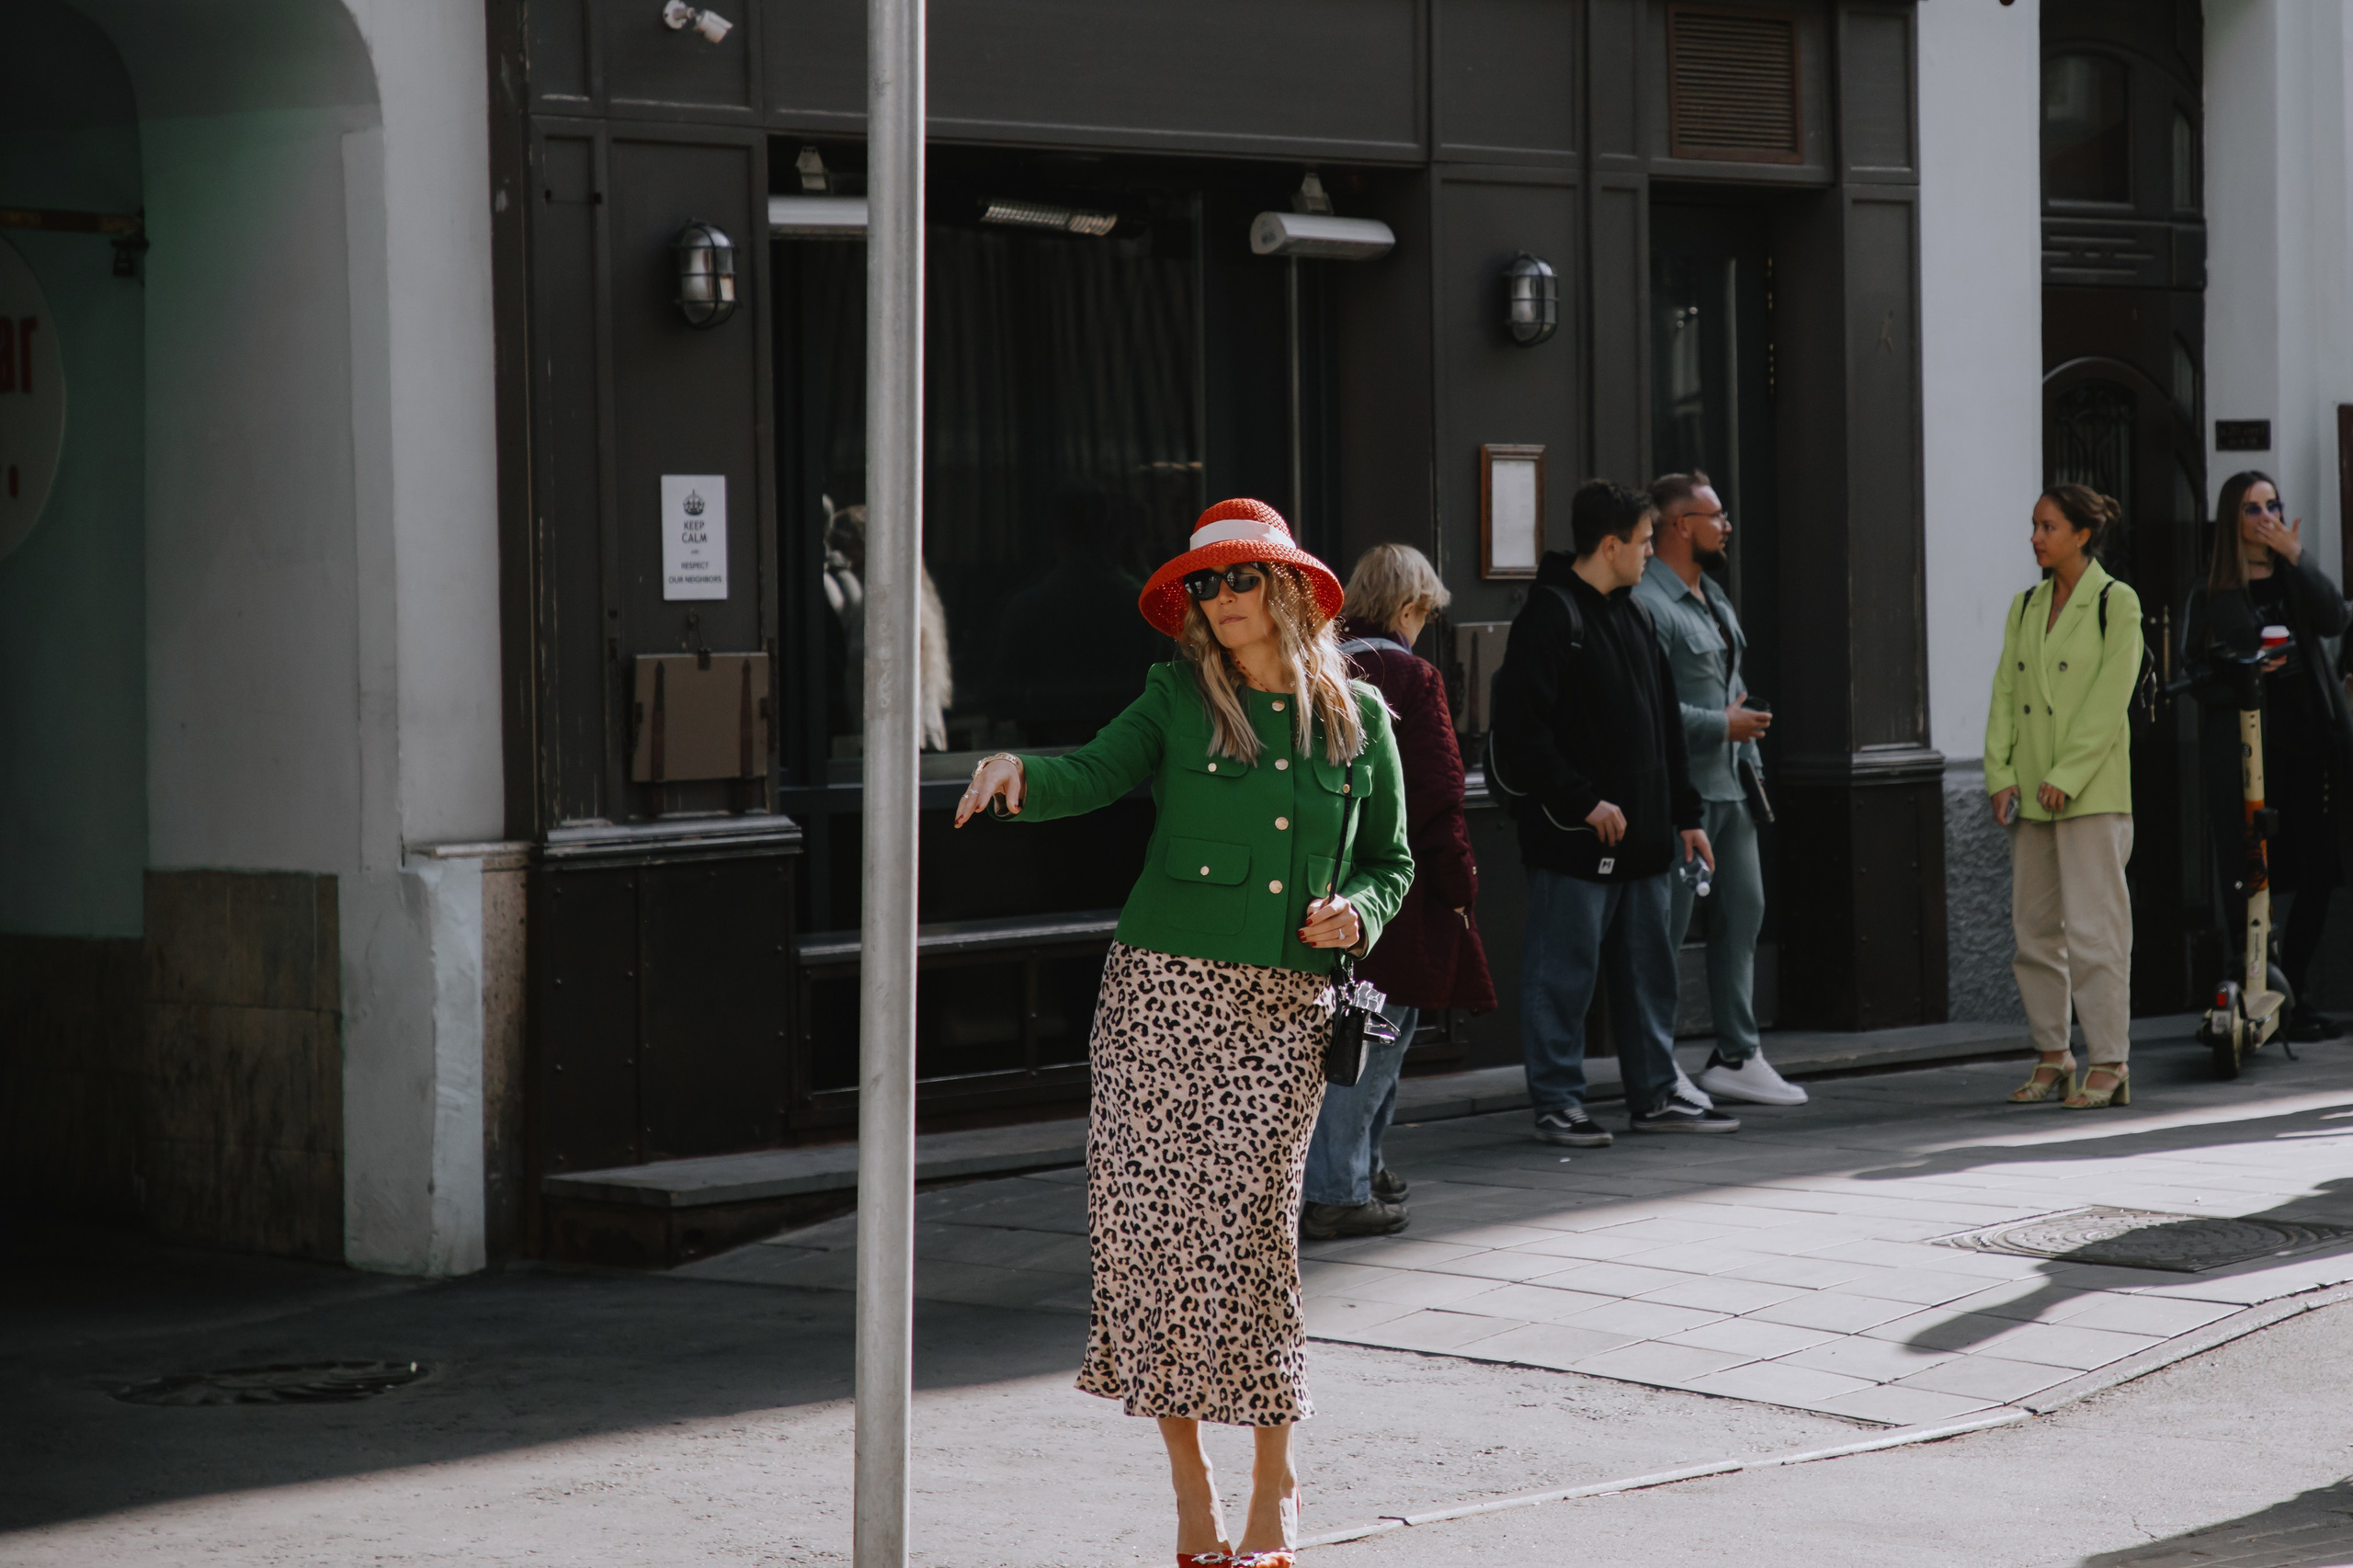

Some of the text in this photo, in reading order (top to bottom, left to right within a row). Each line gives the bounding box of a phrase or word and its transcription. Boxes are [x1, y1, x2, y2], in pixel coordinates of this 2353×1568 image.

[683, 520, 705, 531] KEEP
[681, 532, 708, 544] CALM
[681, 562, 709, 570] RESPECT
[668, 574, 722, 584] OUR NEIGHBORS
